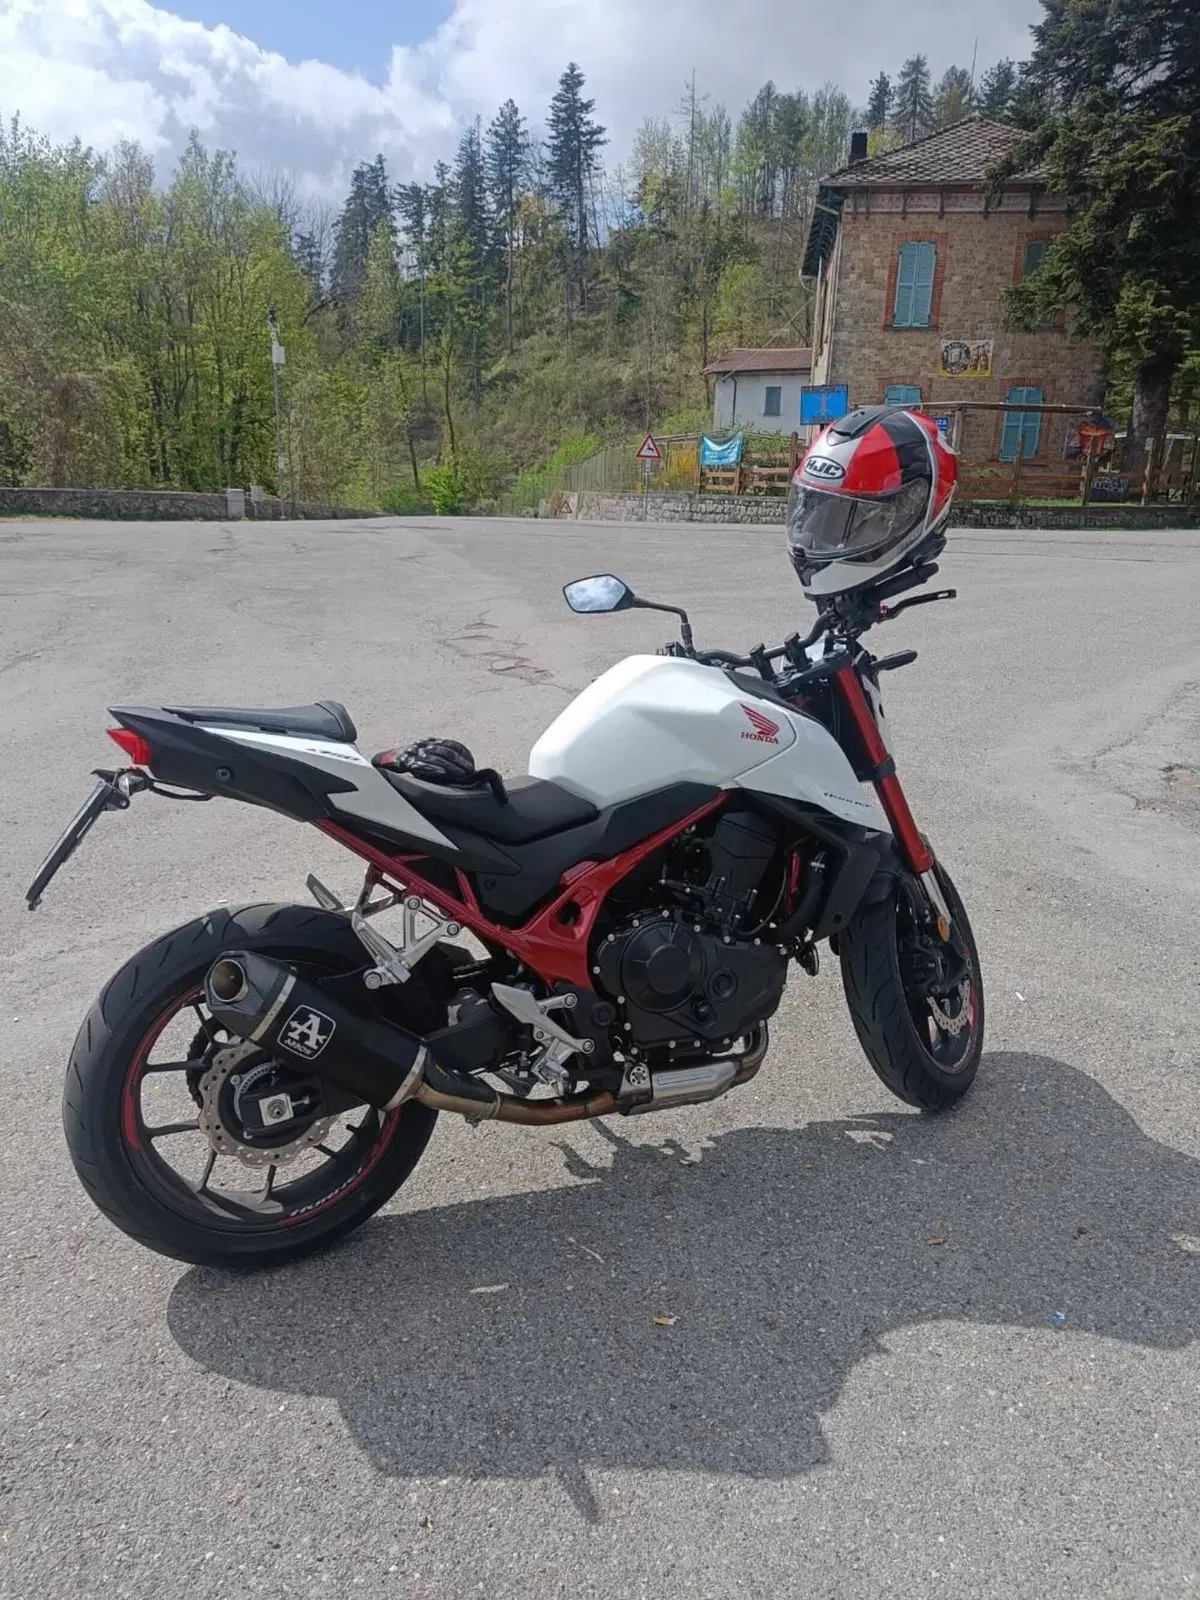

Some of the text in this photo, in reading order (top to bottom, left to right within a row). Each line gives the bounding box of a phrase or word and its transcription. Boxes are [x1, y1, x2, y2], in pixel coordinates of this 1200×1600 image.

[806, 459, 841, 476] HJC
[740, 731, 779, 744] HONDA
[284, 1038, 313, 1055] ARROW
